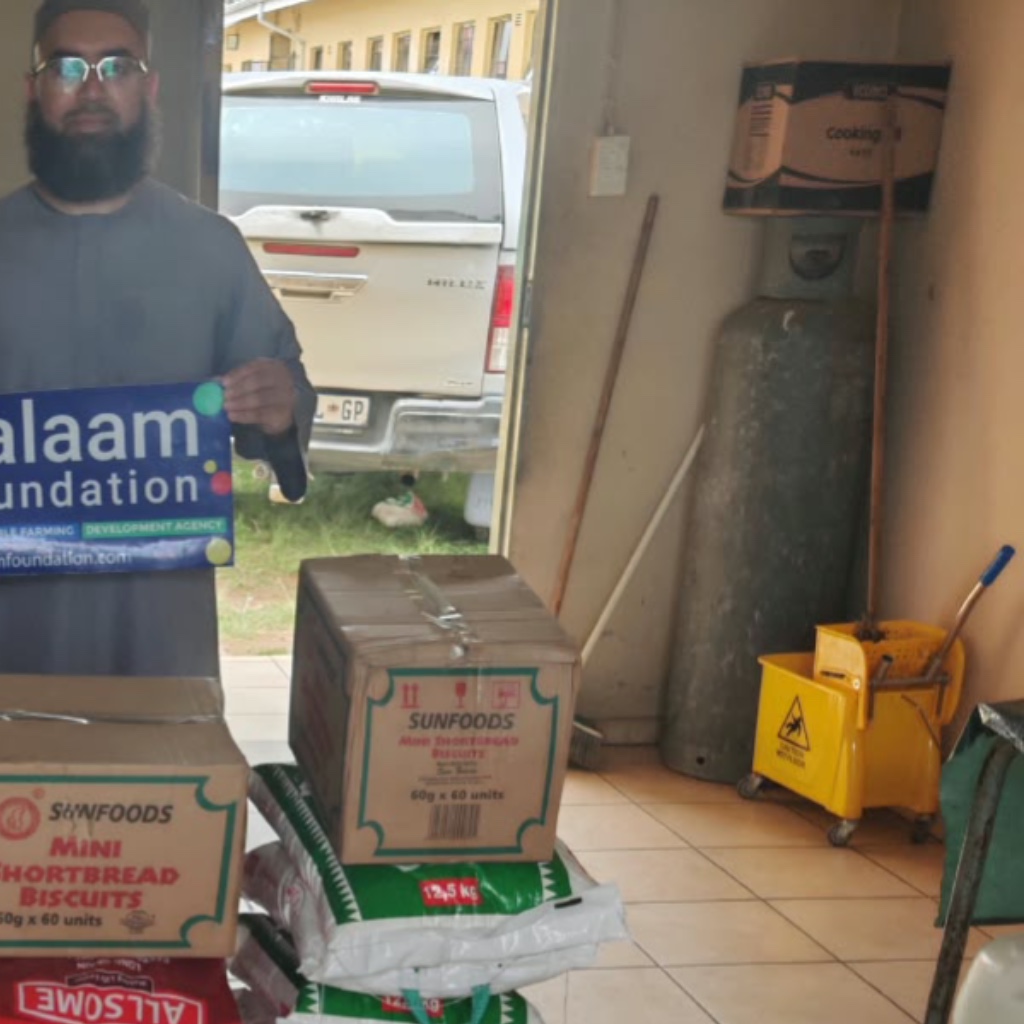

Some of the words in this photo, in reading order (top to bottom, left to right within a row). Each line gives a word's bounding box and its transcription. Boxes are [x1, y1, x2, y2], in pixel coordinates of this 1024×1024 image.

[827, 126, 881, 143] Cooking
[342, 400, 364, 420] GP
[20, 525, 75, 538] FARMING
[86, 521, 174, 536] DEVELOPMENT
[177, 519, 224, 532] AGENCY
[408, 712, 516, 730] SUNFOODS
[410, 790, 435, 803] 60g
[451, 790, 467, 801] 60
[470, 789, 504, 801] units
[49, 802, 173, 824] SUNFOODS
[27, 915, 38, 925] x
[42, 913, 59, 926] 60
[63, 913, 103, 927] units
